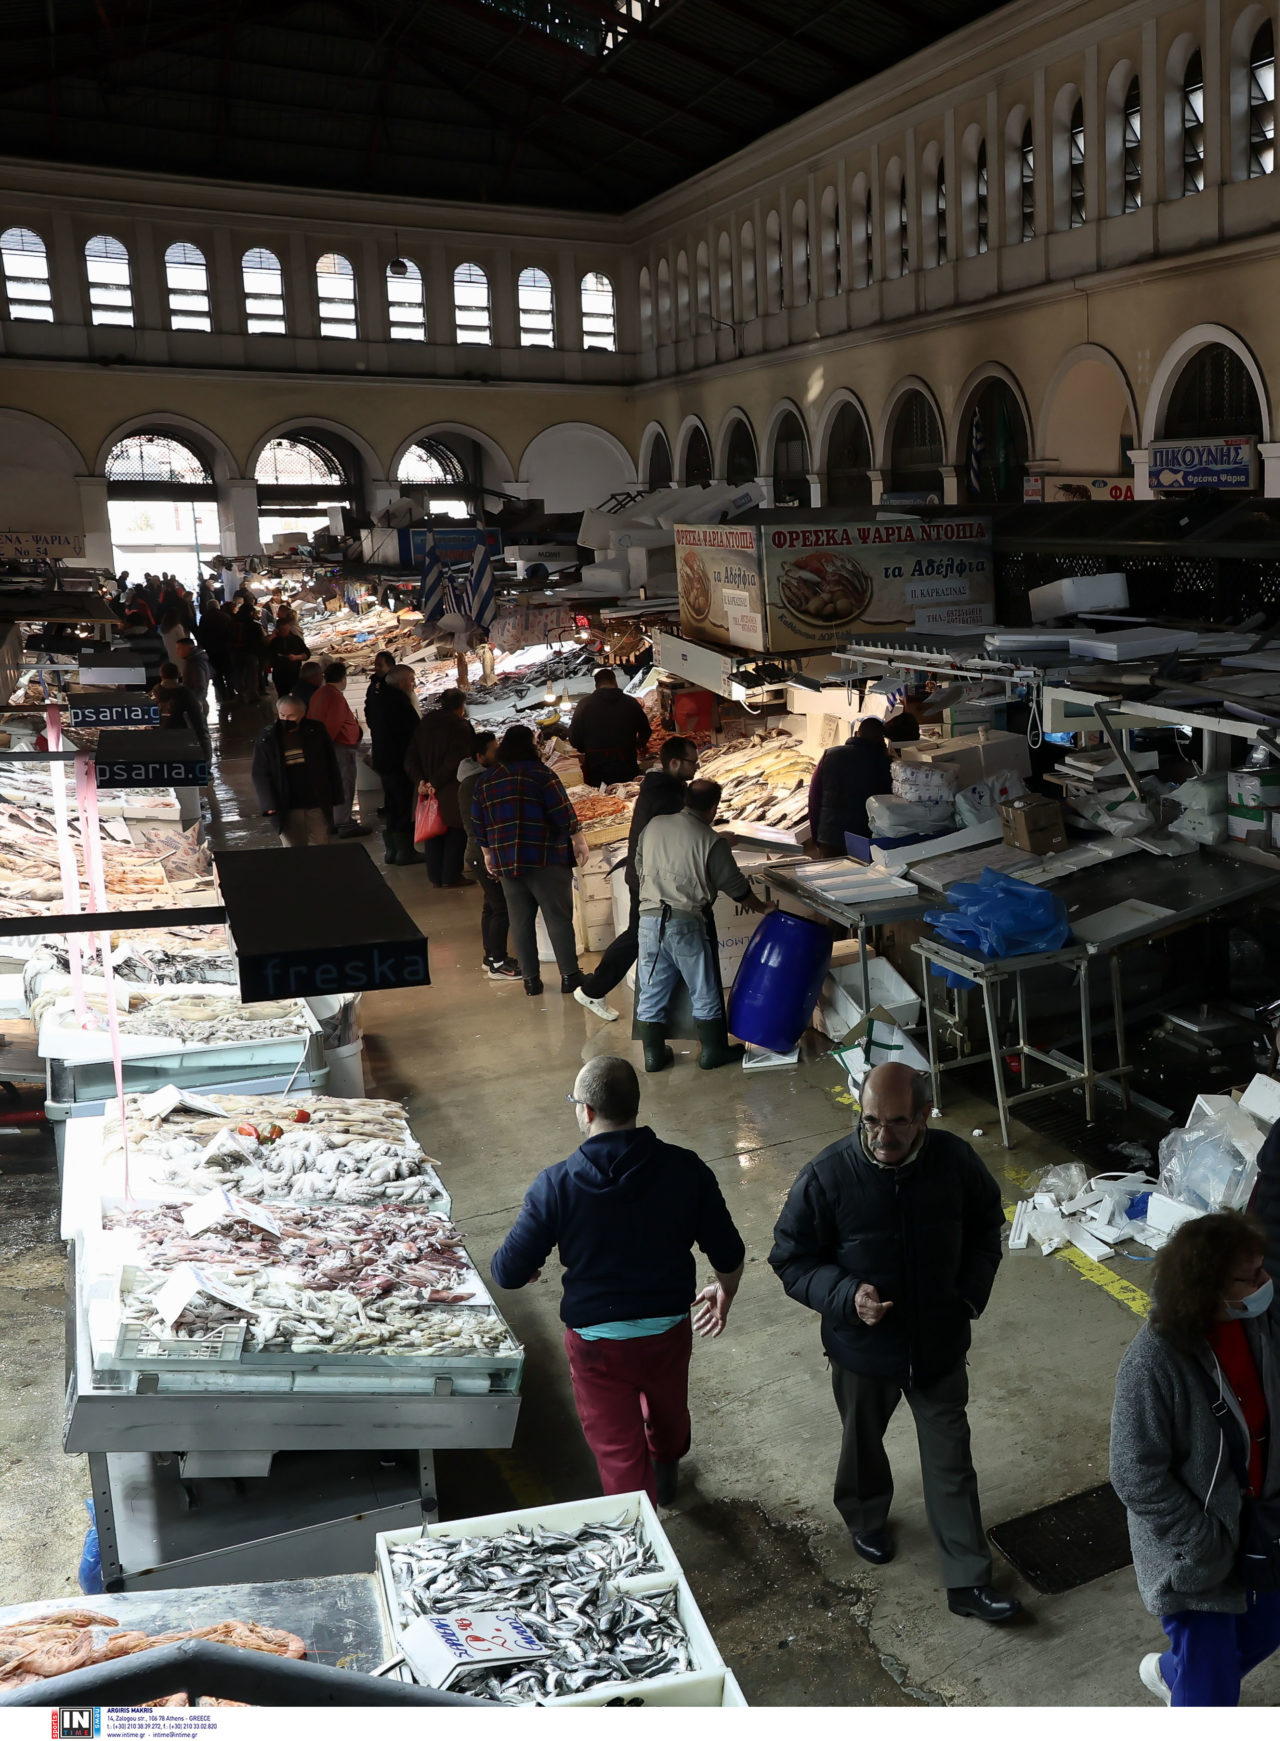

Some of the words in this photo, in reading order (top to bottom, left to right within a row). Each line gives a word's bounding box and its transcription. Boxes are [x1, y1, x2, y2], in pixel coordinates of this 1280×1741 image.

[1153, 446, 1244, 467] ΠΙΚΟΥΝΗΣ
[1187, 474, 1218, 484] Φρέσκα
[1220, 473, 1246, 484] Ψάρια
[32, 535, 71, 545] ΨΑΡΙΑ
[676, 529, 702, 547] ΦΡΕΣΚΑ
[702, 530, 724, 548] ΨΑΡΙΑ
[725, 531, 755, 549] ΝΤΟΠΙΑ
[772, 528, 854, 549] ΦΡΕΣΚΑ
[857, 525, 915, 545] ΨΑΡΙΑ
[921, 522, 986, 542] ΝΤΟΠΙΑ
[35, 547, 49, 556] 54
[883, 565, 904, 579] τα
[910, 556, 986, 579] Αδέλφια
[264, 948, 426, 995] freska
